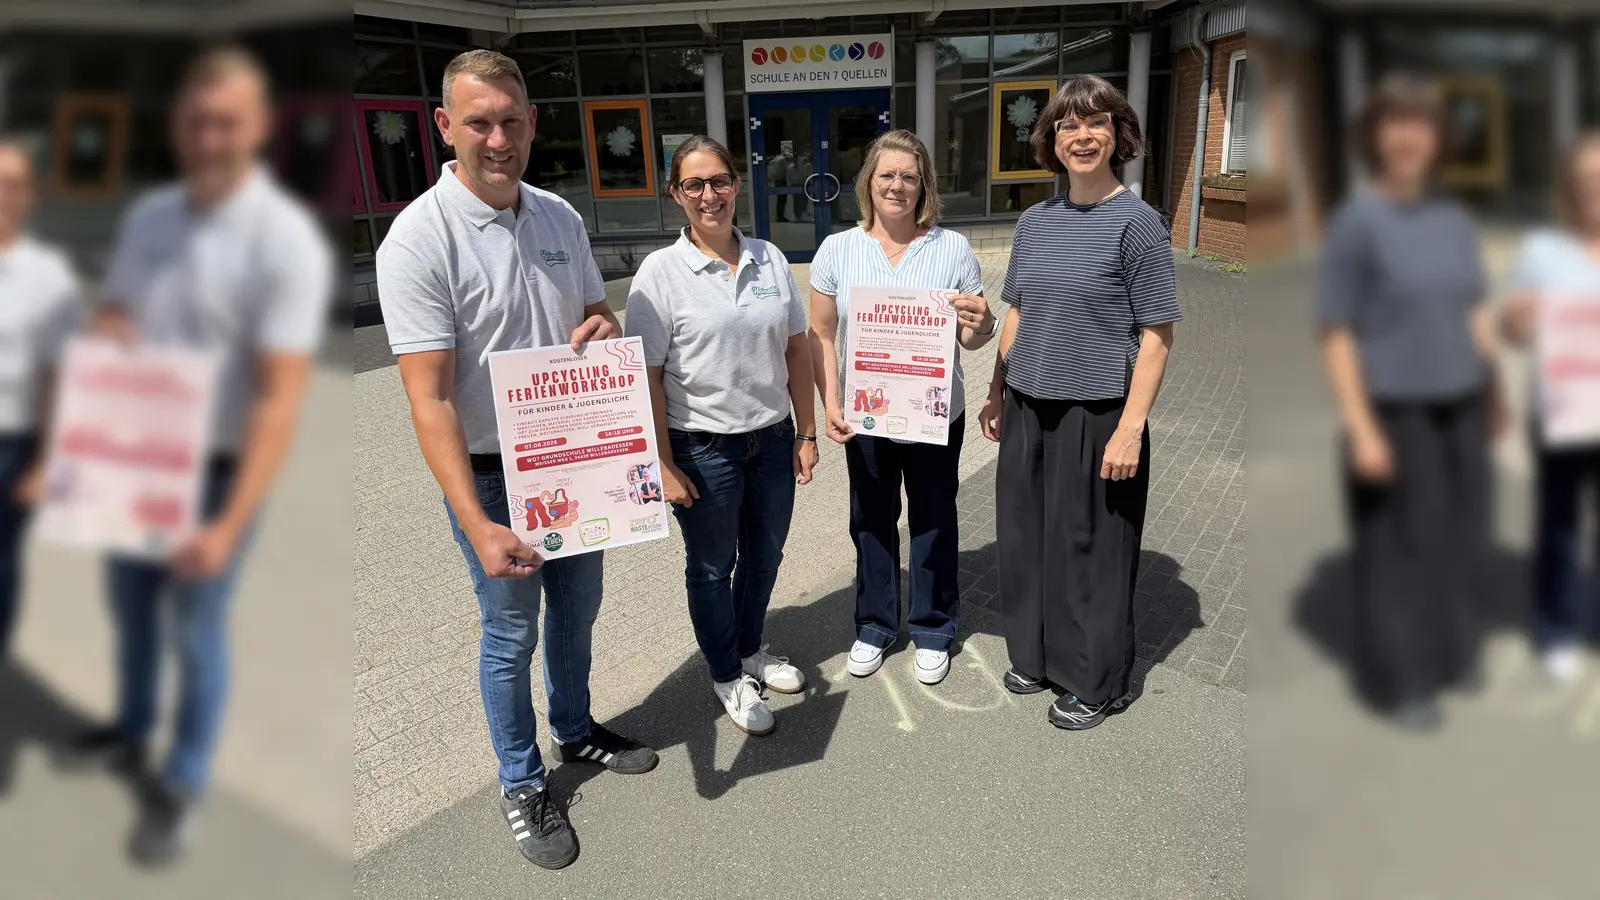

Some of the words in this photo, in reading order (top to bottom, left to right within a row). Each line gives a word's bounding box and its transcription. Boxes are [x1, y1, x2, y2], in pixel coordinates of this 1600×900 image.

[751, 73, 790, 83] SCHULE
[793, 72, 806, 82] AN
[810, 71, 830, 81] DEN
[833, 71, 839, 80] 7
[841, 69, 887, 80] QUELLEN
[875, 304, 930, 316] UPCYCLING
[857, 313, 947, 327] FERIENWORKSHOP
[550, 355, 588, 364] KOSTENLOSER
[532, 364, 609, 386] UPCYCLING
[508, 374, 635, 402] FERIENWORKSHOP
[518, 406, 534, 416] FÜR
[536, 404, 566, 414] KINDER
[576, 395, 630, 408] JUGENDLICHE
[524, 440, 557, 449] 07.08.2026
[541, 448, 585, 460] GRUNDSCHULE
[586, 441, 633, 453] WILLEBADESSEN
[590, 447, 628, 457] WILLEBADESSEN
[629, 515, 656, 526] zero
